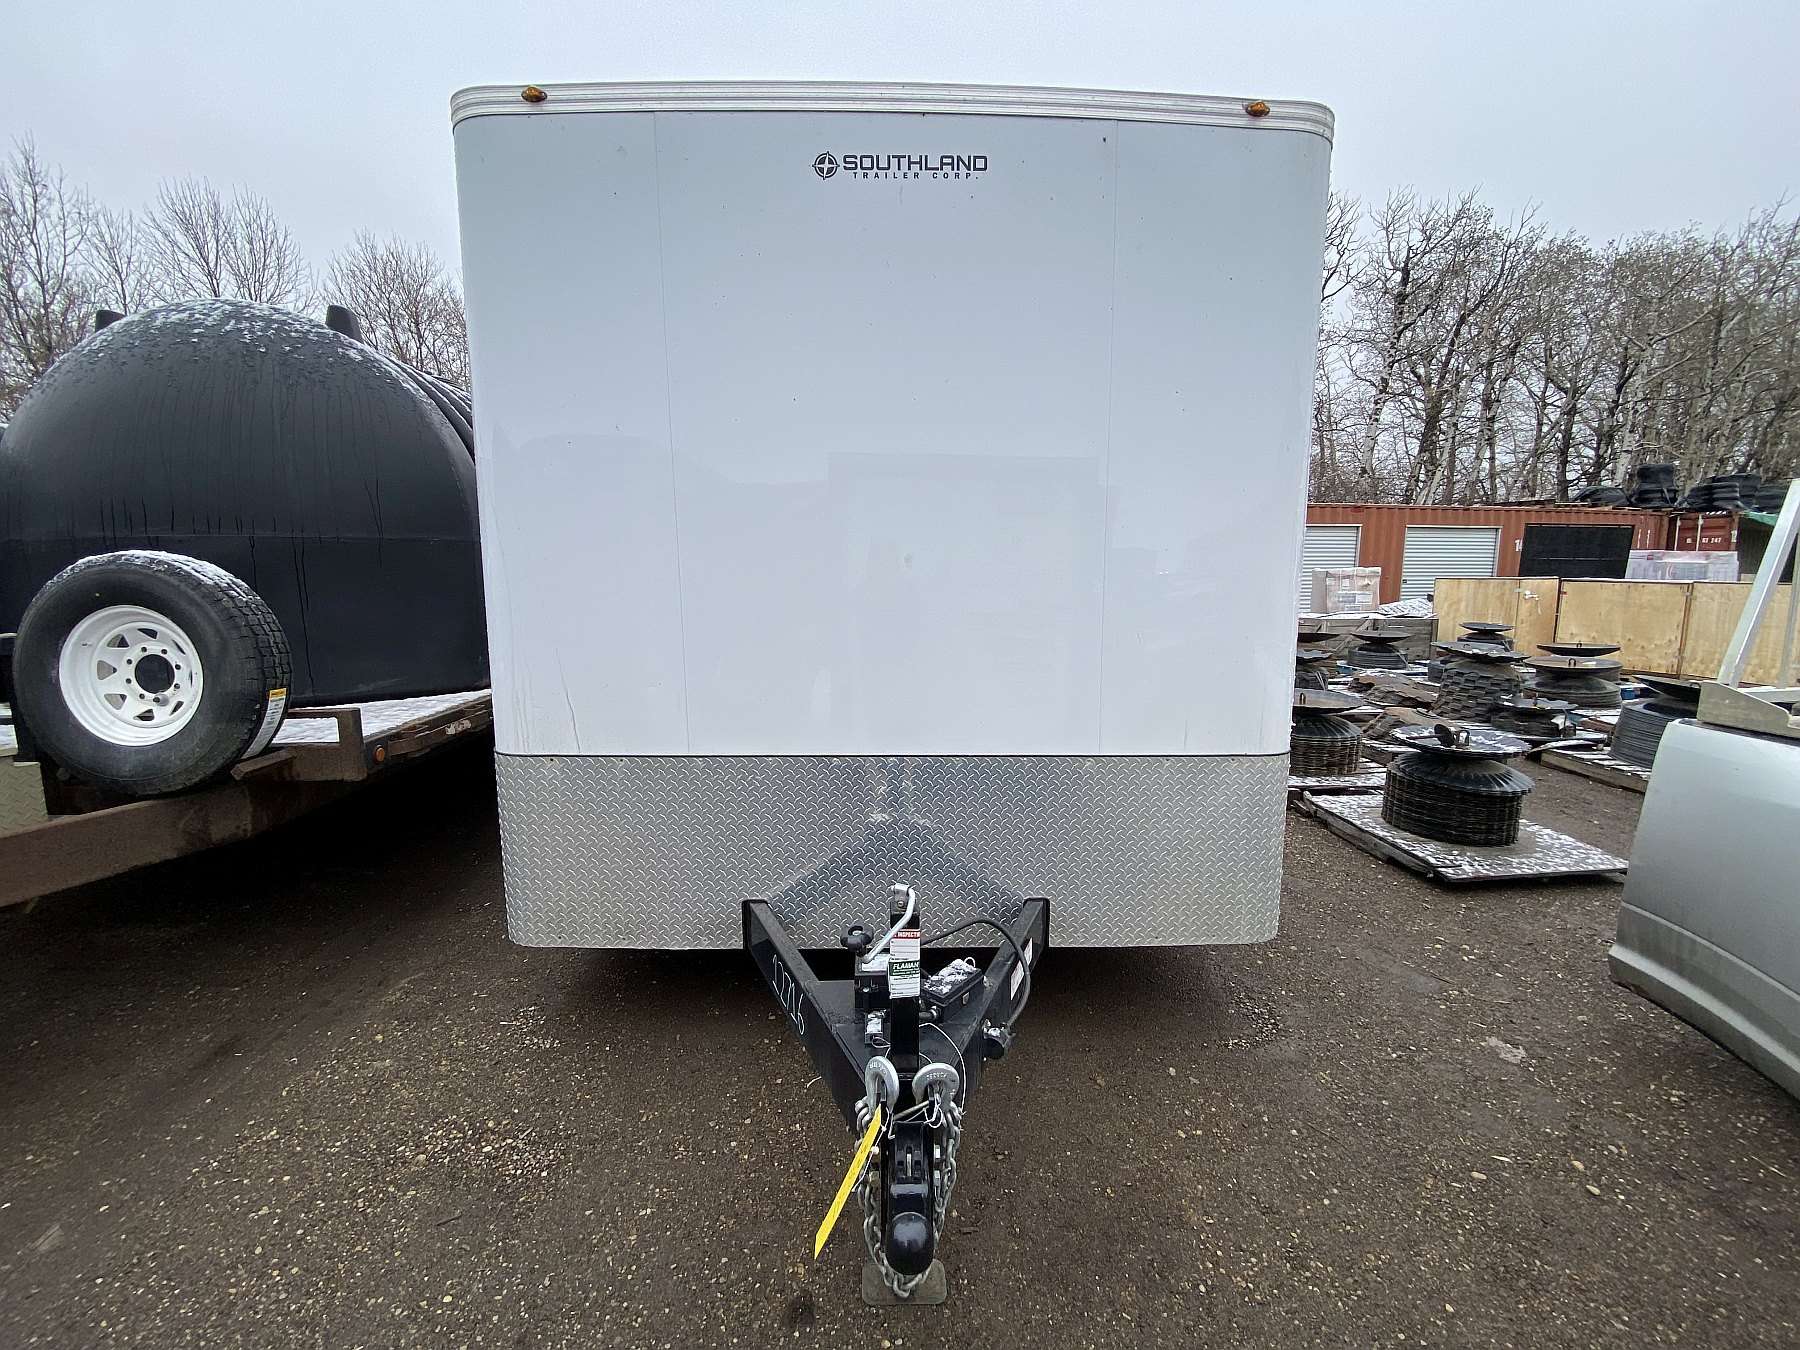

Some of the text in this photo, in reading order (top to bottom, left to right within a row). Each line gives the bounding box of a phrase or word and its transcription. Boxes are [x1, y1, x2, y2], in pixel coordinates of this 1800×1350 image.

[842, 154, 988, 171] SOUTHLAND
[853, 171, 979, 180] TRAILER CORP.
